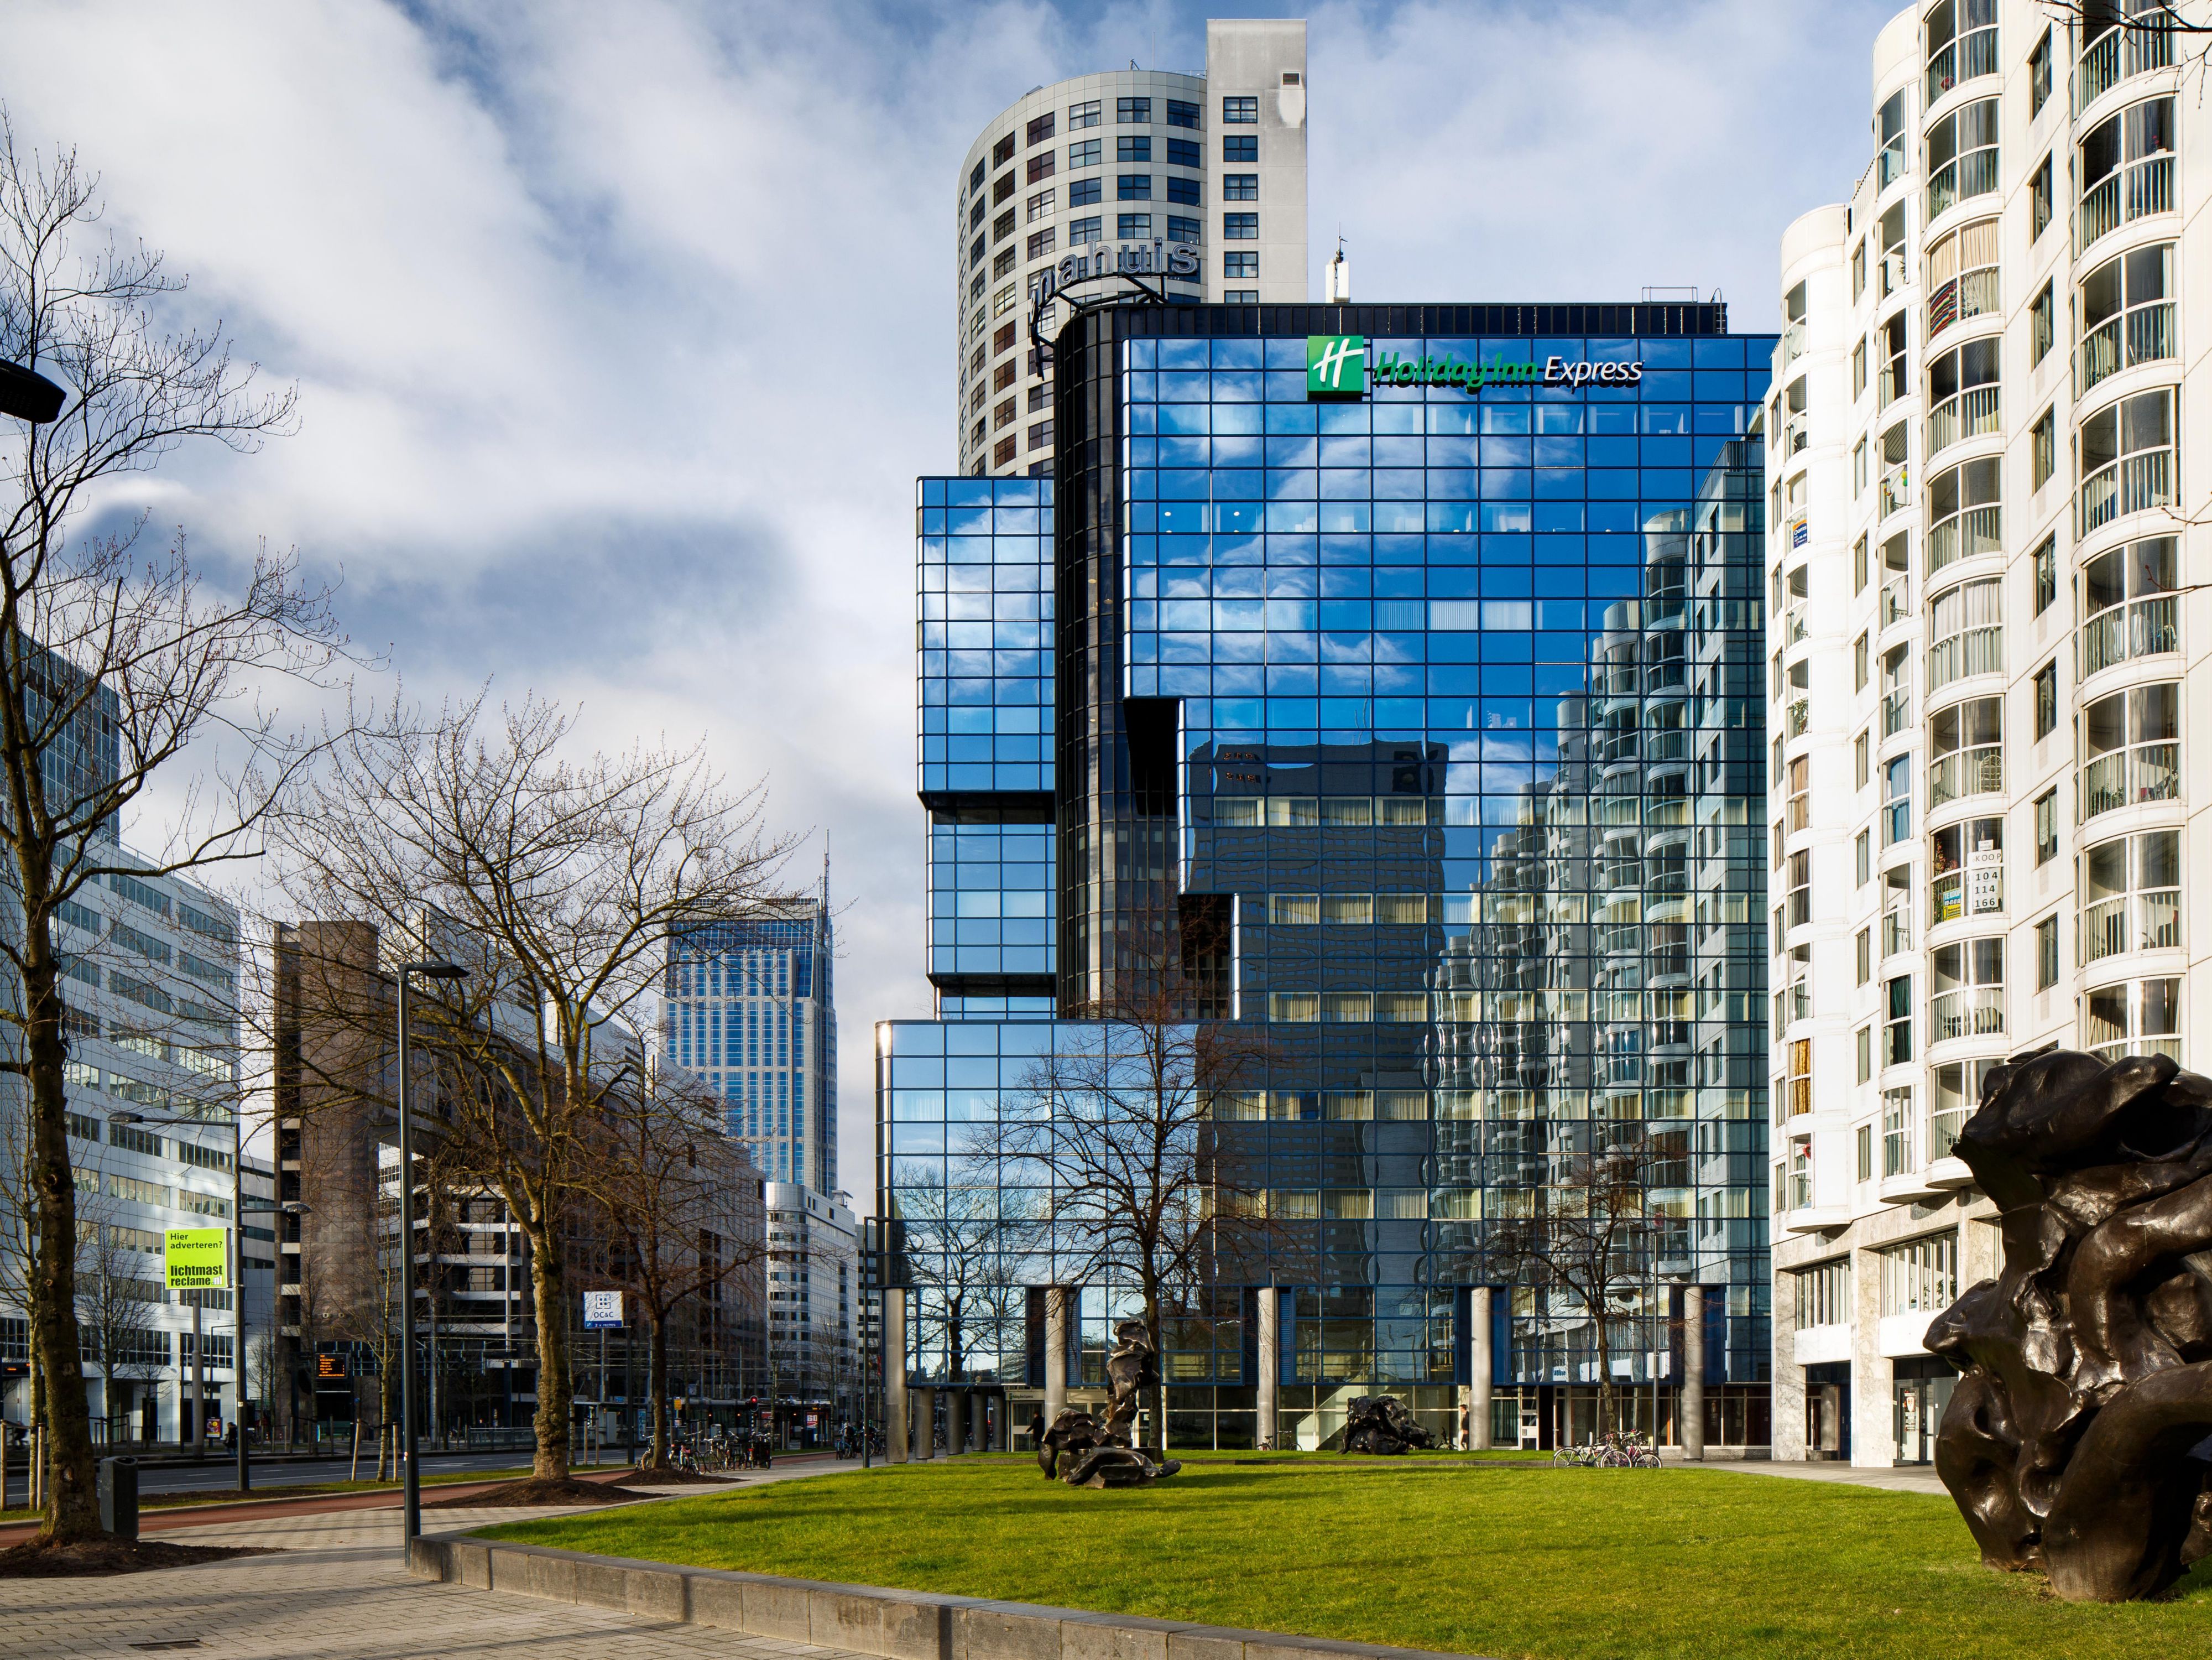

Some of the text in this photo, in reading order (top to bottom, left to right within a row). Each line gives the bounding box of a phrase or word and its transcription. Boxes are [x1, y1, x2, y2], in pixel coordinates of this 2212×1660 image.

[1374, 351, 1643, 389] Holiday Inn Express
[1976, 872, 1997, 881] 104
[1975, 885, 1995, 894] 114
[1975, 898, 1995, 907] 166
[170, 1265, 222, 1276] lichtmast
[171, 1275, 222, 1286] reclame.nl
